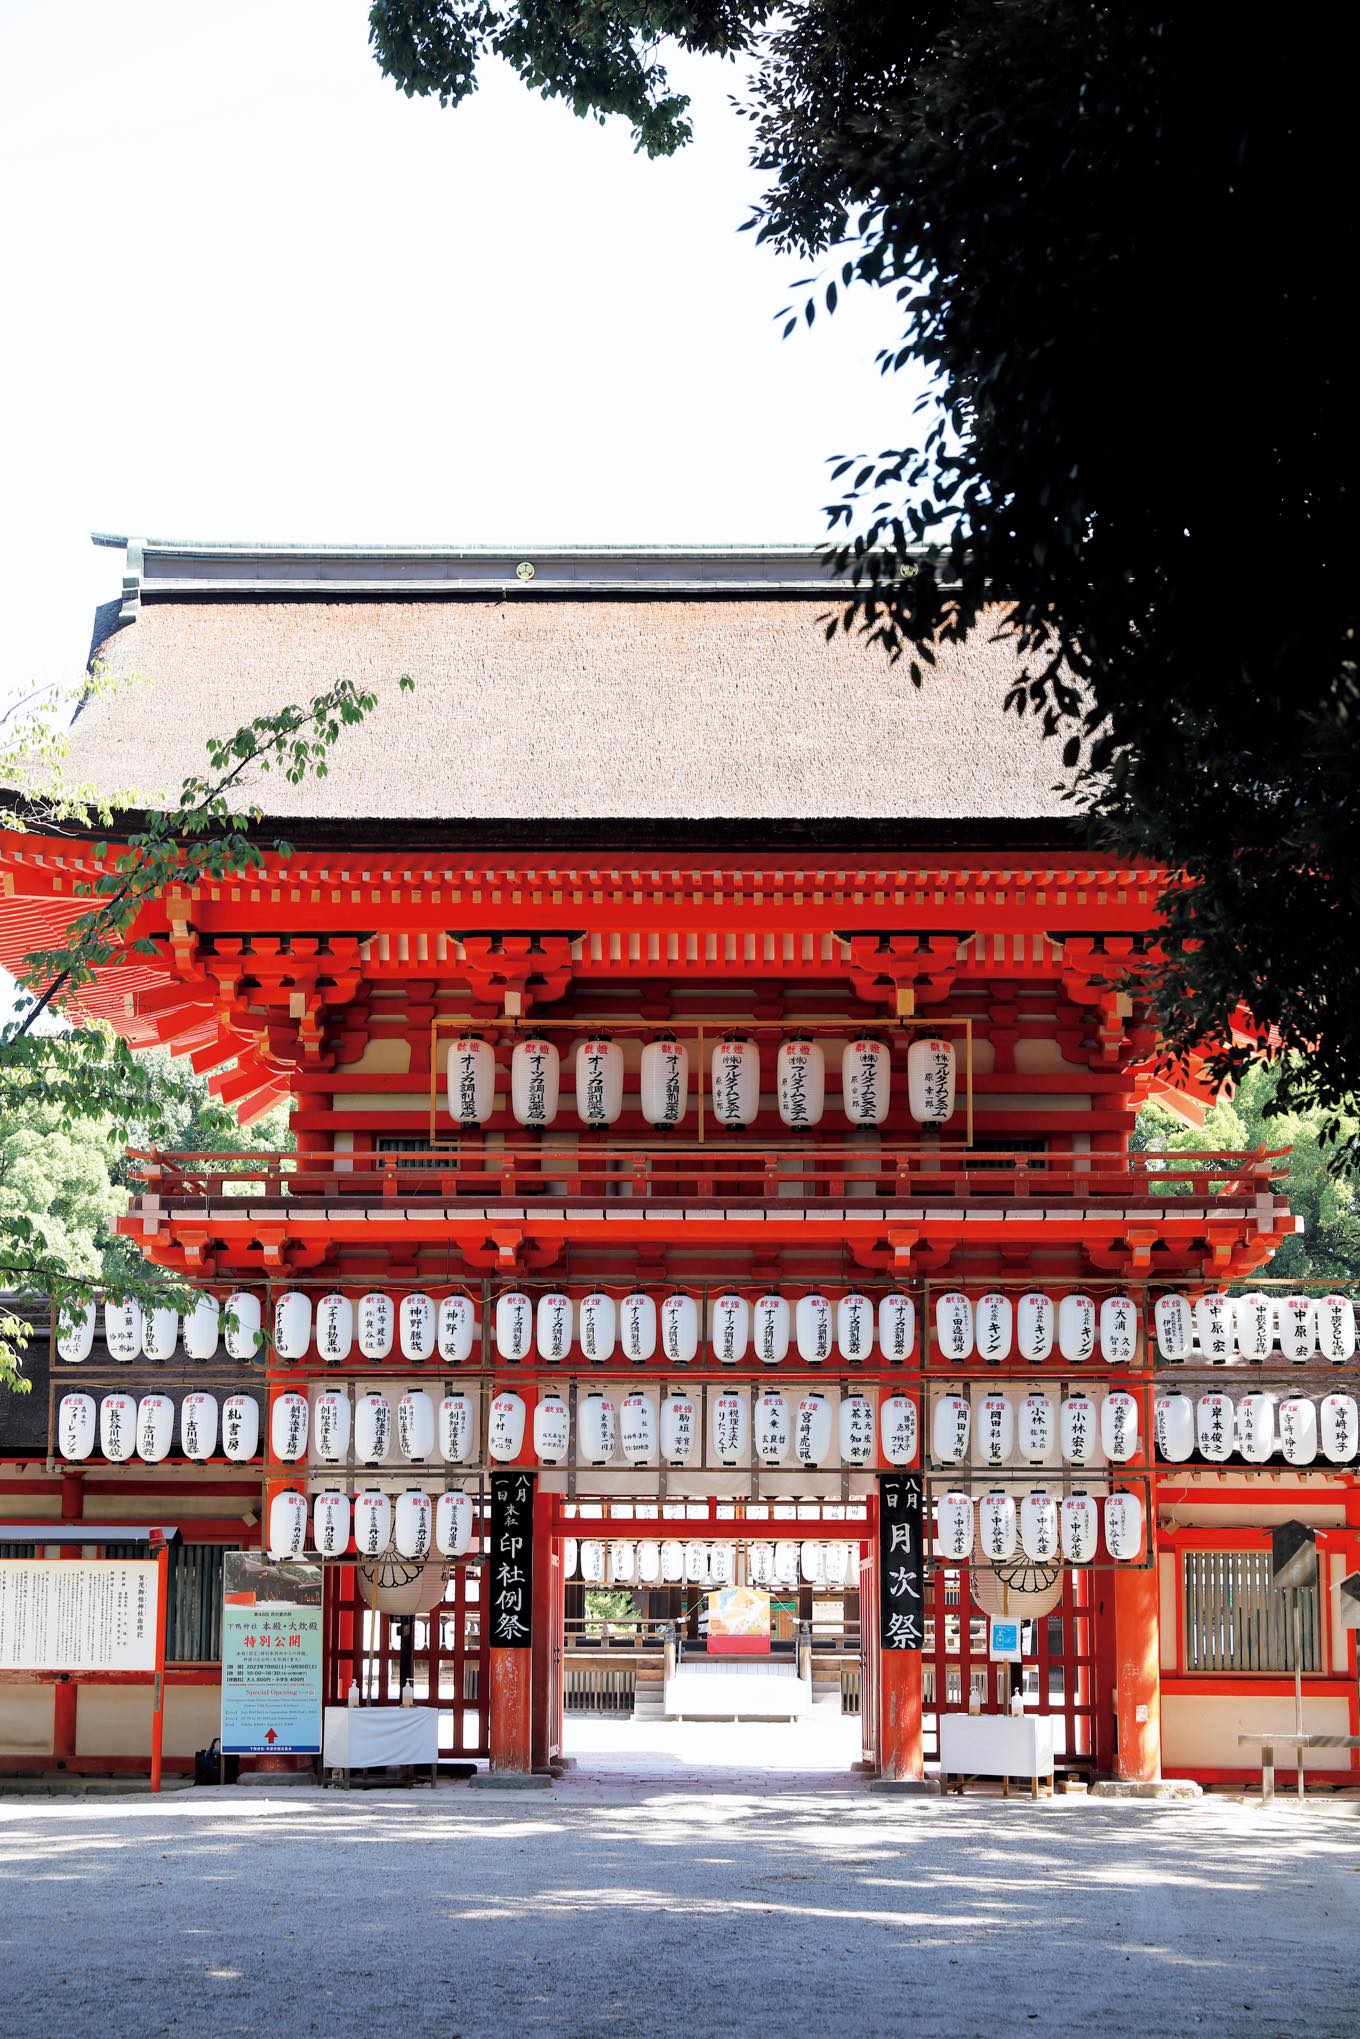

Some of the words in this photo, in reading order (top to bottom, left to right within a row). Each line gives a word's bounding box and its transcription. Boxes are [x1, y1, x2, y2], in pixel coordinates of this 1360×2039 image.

[460, 1054, 476, 1118] オーツカ調剤薬局
[527, 1055, 546, 1119] オーツカ調剤薬局
[587, 1055, 606, 1119] オーツカ調剤薬局
[662, 1053, 681, 1121] オーツカ調剤薬局
[377, 1305, 386, 1346] 社寺建築
[1115, 1309, 1126, 1330] 大浦
[1210, 1305, 1225, 1352] 中原宏
[1294, 1309, 1308, 1356] 中原宏
[729, 1409, 739, 1448] 税理士法人
[1032, 1408, 1045, 1424] 小林
[1071, 1412, 1086, 1458] 小林宏史
[1211, 1406, 1223, 1453] 岸本俊之
[496, 1480, 508, 1501] 一日
[515, 1475, 530, 1502] 八月
[885, 1484, 899, 1507] 一日
[906, 1478, 920, 1509] 八月
[495, 1533, 529, 1639] 印社例祭
[885, 1523, 923, 1650] 月次祭
[244, 1635, 301, 1648] 特別公開
